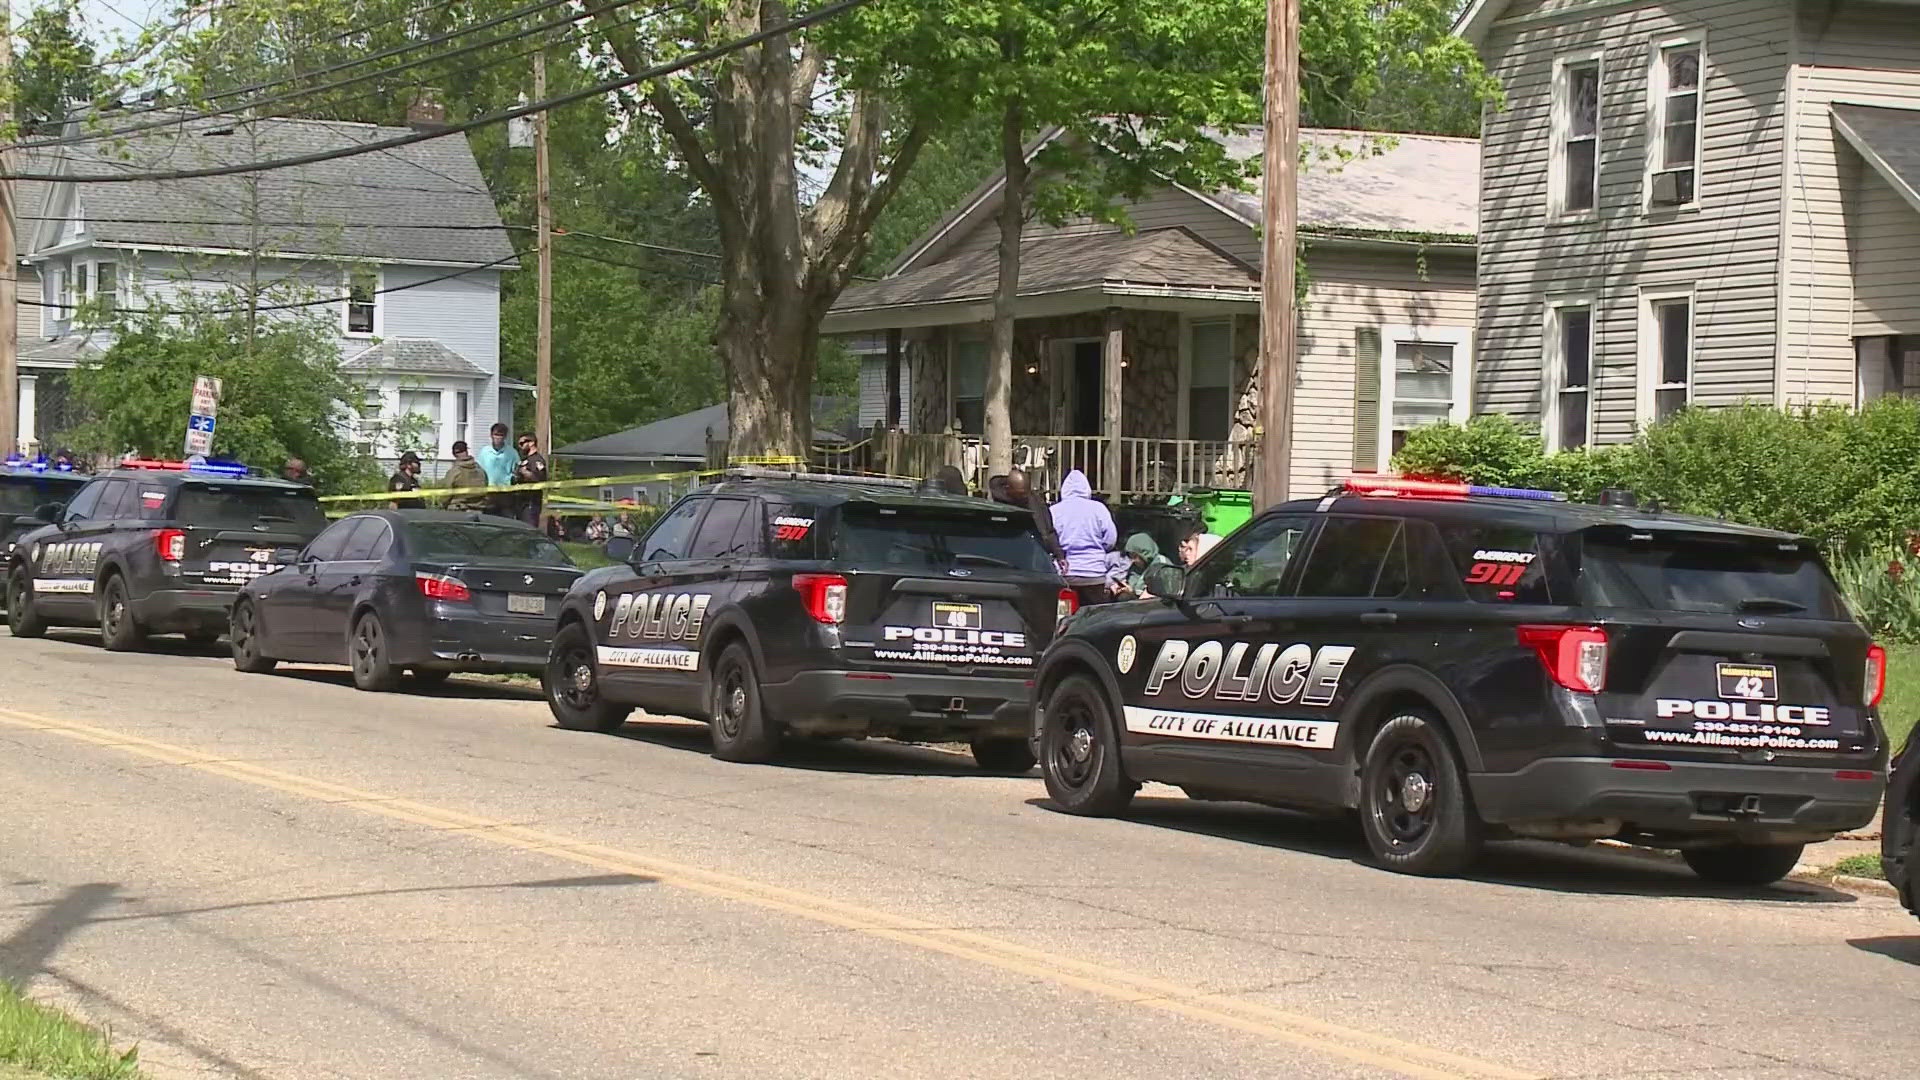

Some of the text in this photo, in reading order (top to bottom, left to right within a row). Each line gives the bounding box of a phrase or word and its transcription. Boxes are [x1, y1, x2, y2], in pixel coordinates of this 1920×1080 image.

[774, 526, 809, 540] 911
[40, 542, 103, 574] POLICE
[209, 561, 287, 574] POLI
[1464, 562, 1526, 585] 911
[609, 593, 712, 640] POLICE
[884, 626, 1026, 648] POLICE
[609, 651, 690, 667] CITY OF ALLIANCE
[874, 649, 1033, 665] www.AlliancePolice.com
[1144, 640, 1356, 707] POLICE
[1735, 676, 1764, 698] 42
[1656, 699, 1830, 726] POLICE
[1149, 715, 1319, 743] CITY OF ALLIANCE
[1693, 721, 1801, 735] 330-821-9140
[1644, 730, 1839, 749] www.AlliancePolice.com
